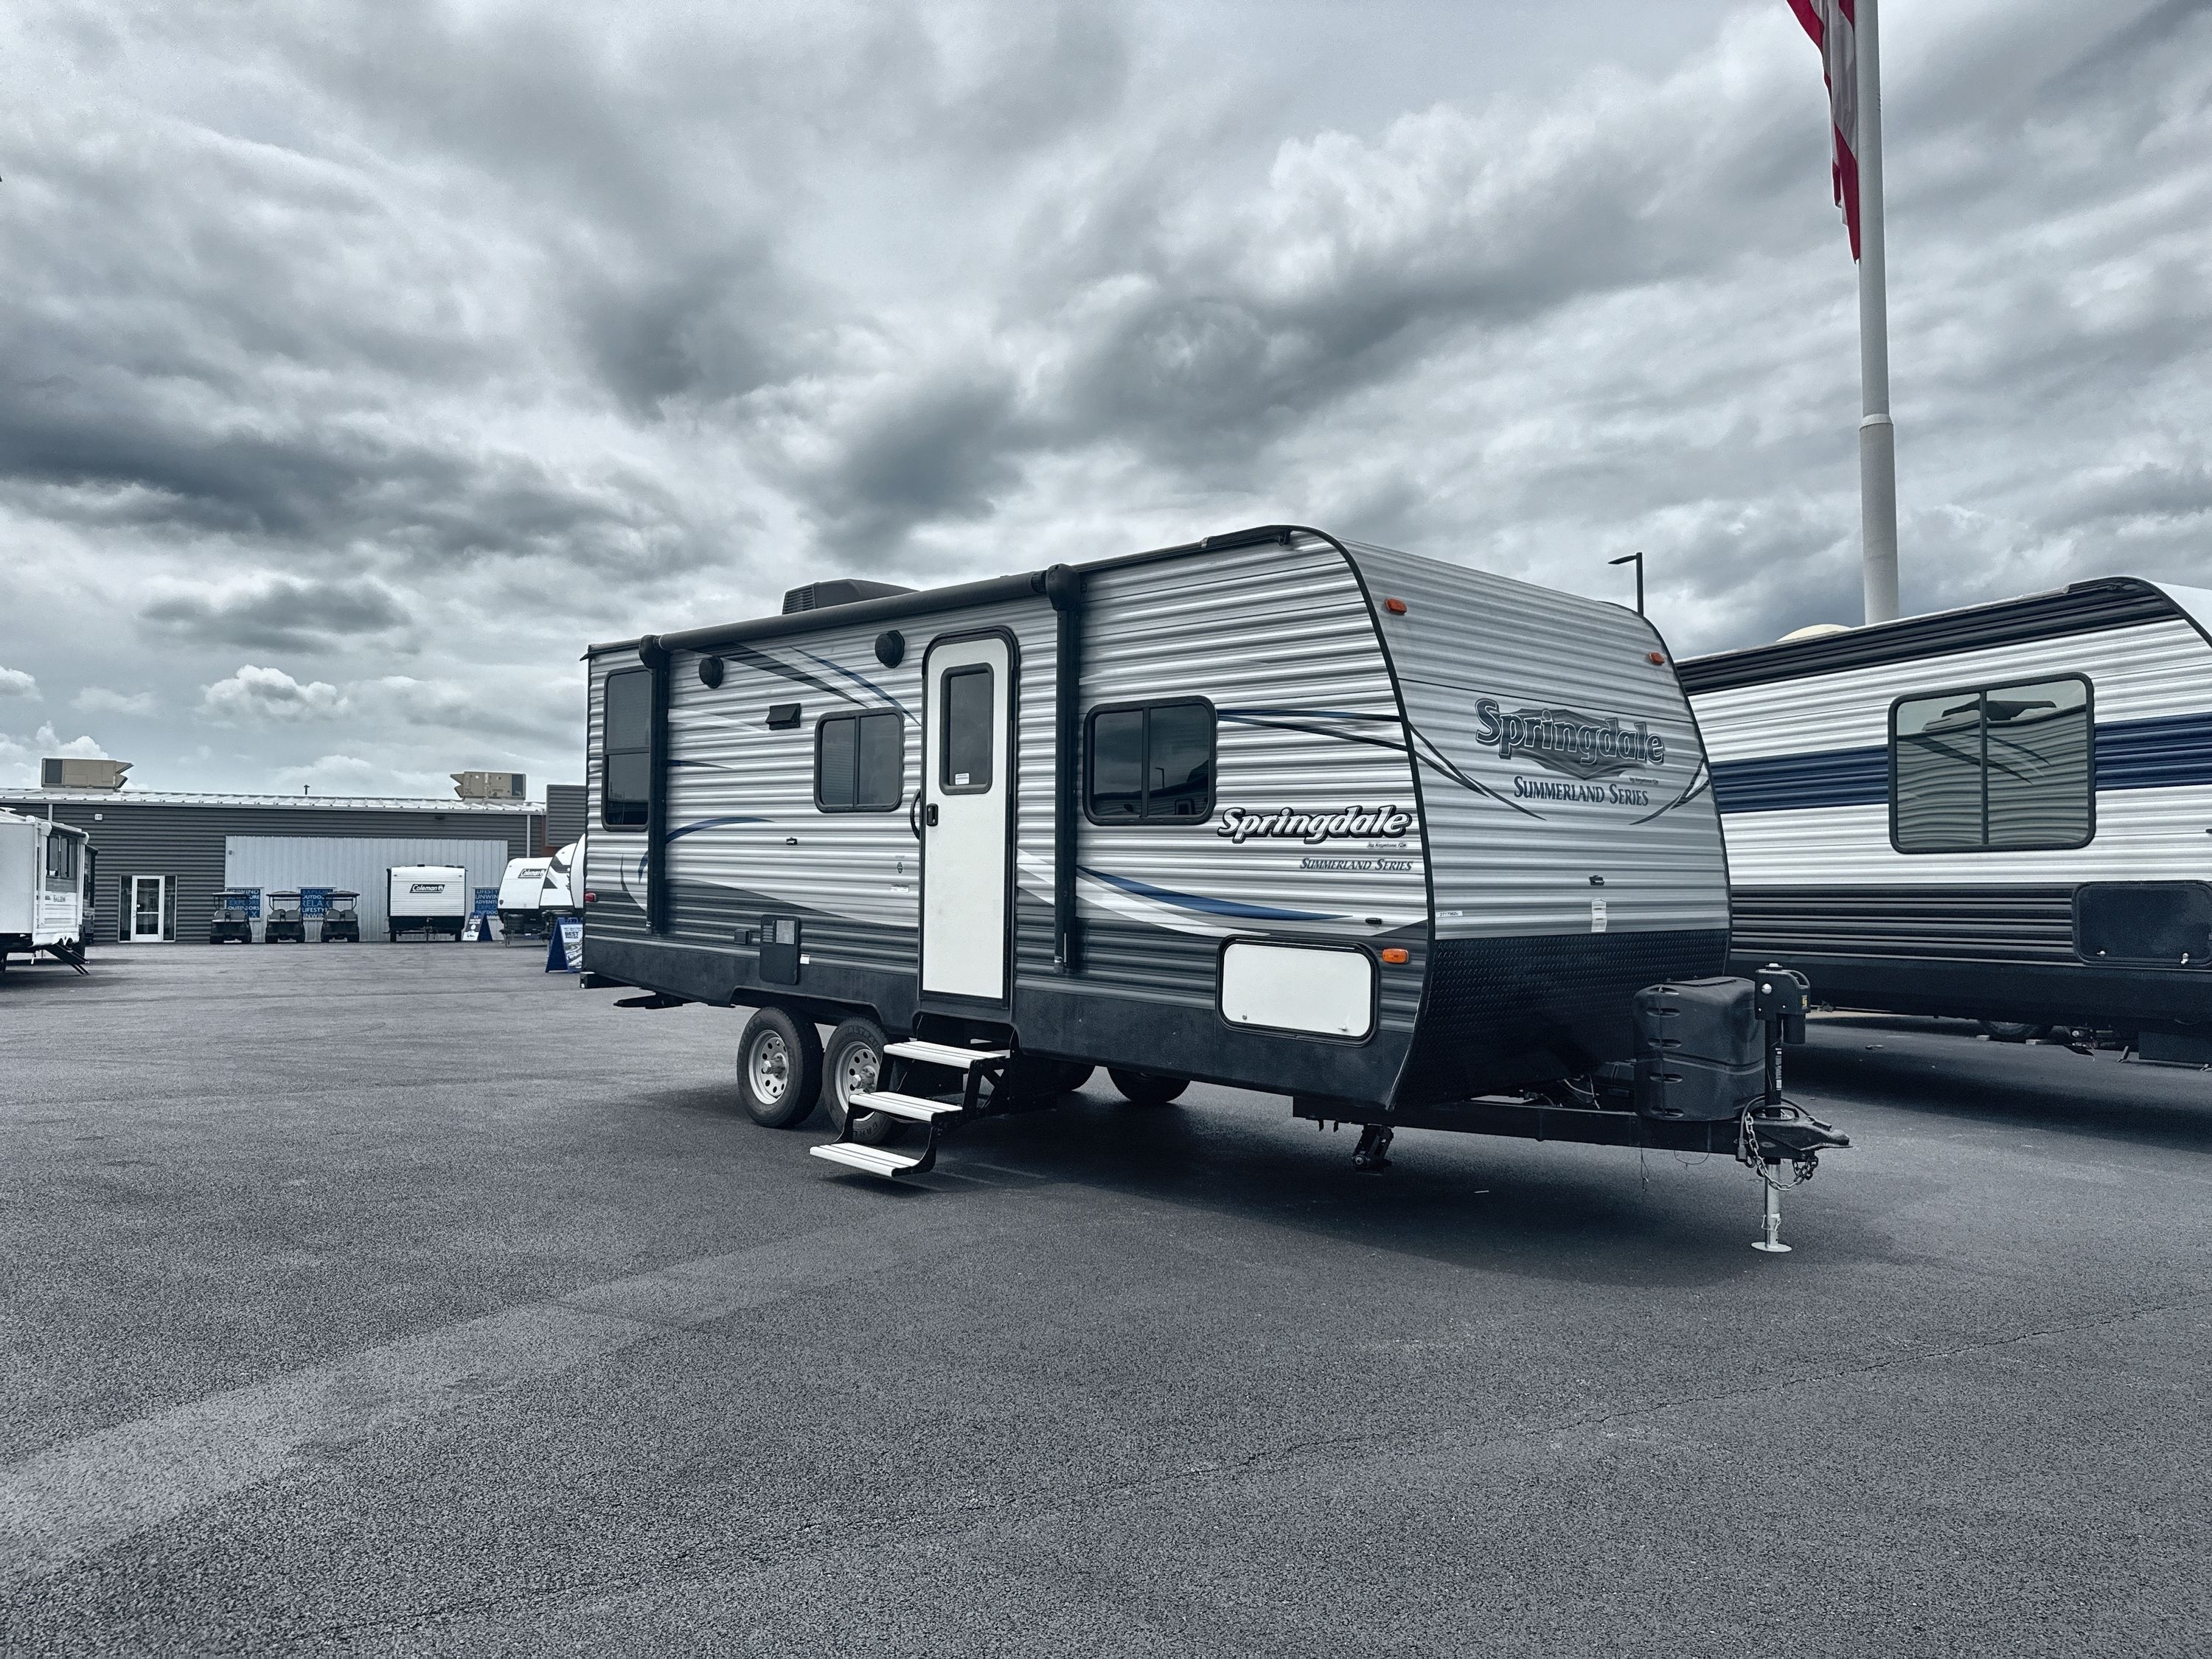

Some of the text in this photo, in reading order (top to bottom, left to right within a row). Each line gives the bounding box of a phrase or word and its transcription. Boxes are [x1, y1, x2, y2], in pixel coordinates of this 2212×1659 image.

[1475, 698, 1666, 765] Springdale
[1514, 776, 1649, 807] SUMMERLAND SERIES
[1217, 804, 1412, 844] Springdale
[521, 869, 541, 877] Coleman
[1300, 858, 1413, 871] SUMMERLAND SERIES
